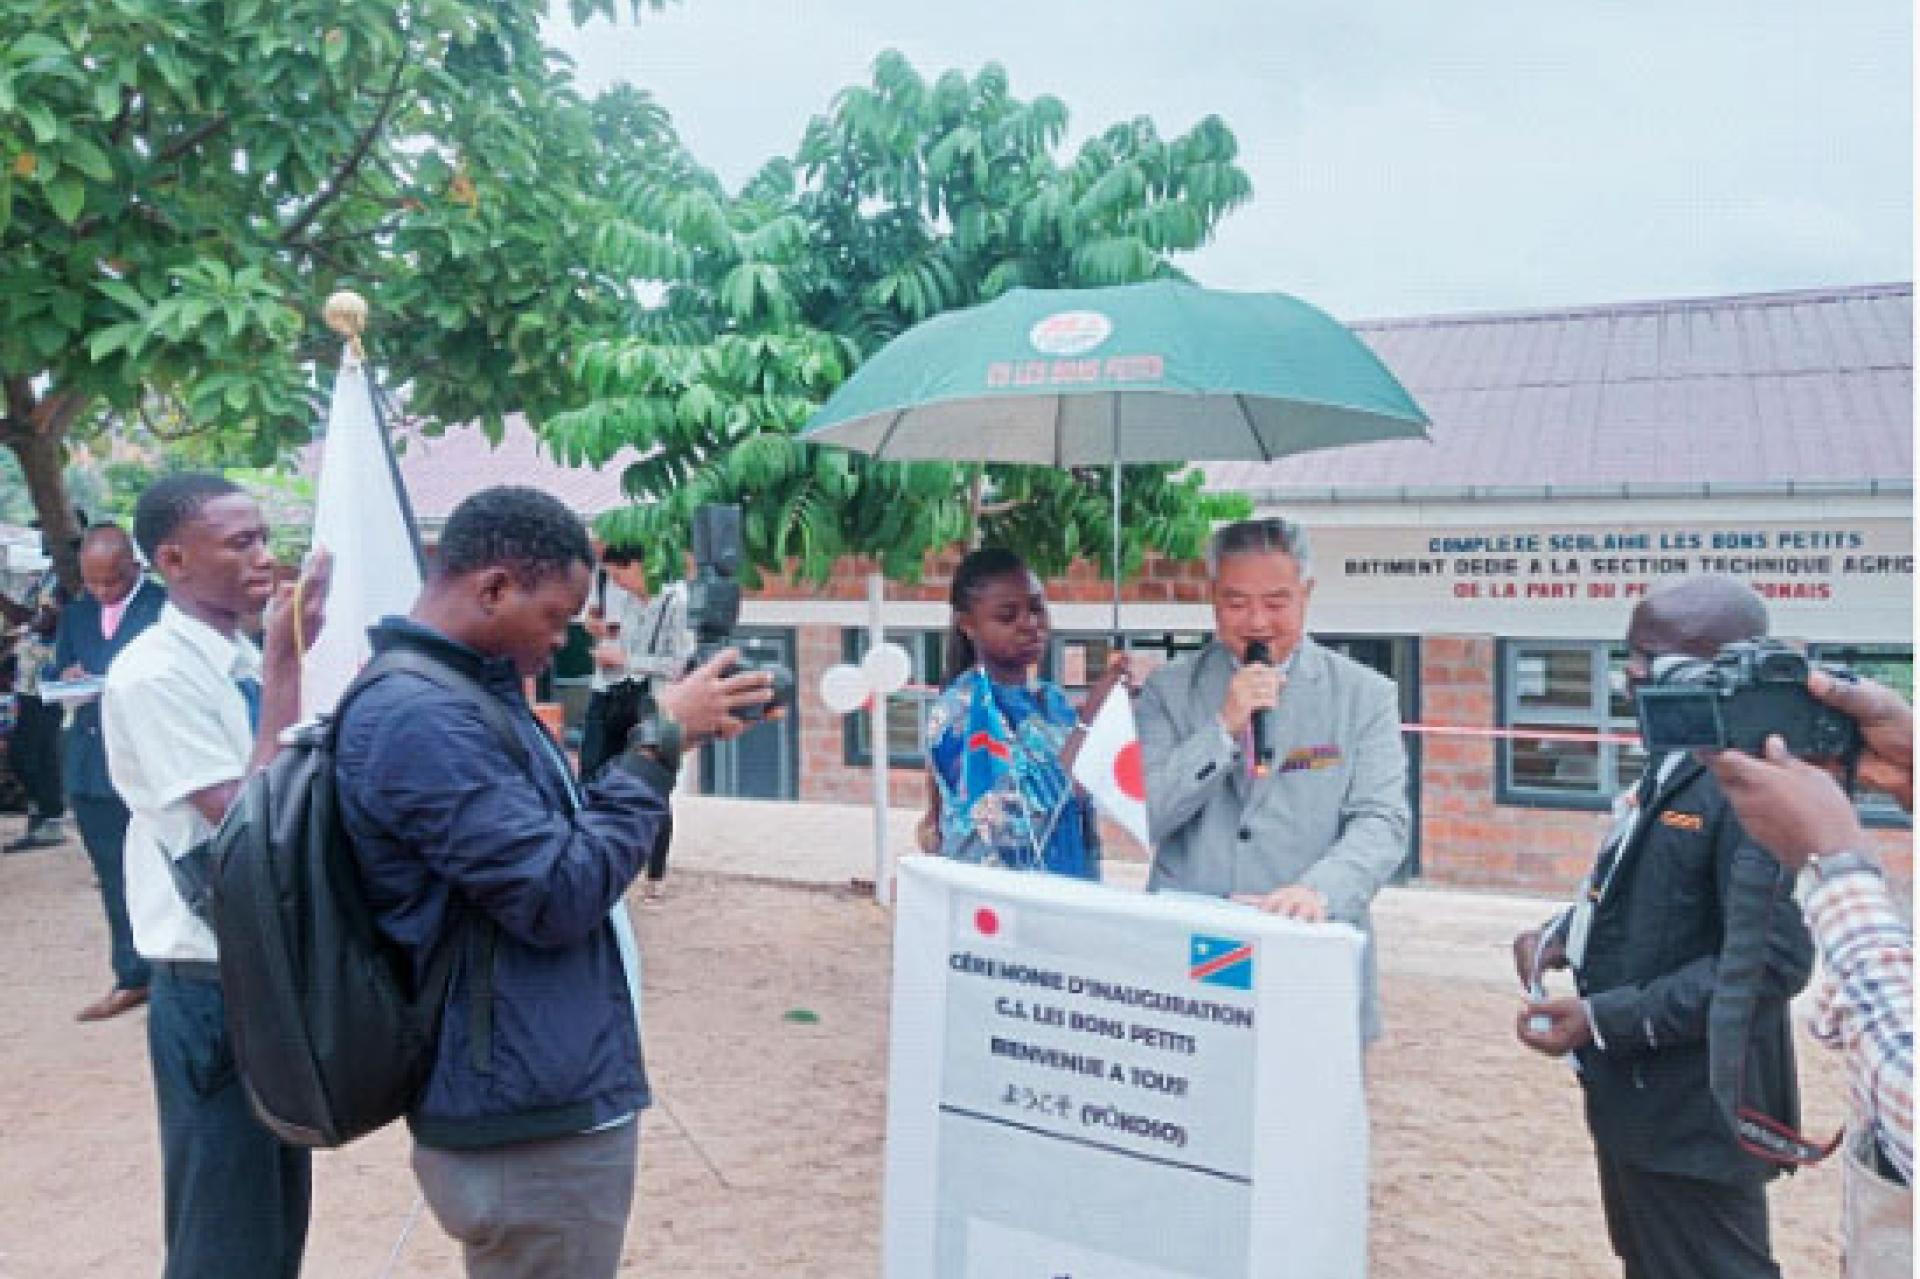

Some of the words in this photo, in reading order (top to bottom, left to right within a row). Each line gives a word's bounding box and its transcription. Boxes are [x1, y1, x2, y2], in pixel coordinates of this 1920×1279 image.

[1429, 534, 1539, 552] COMPLEXE
[1660, 533, 1702, 550] LES
[1712, 532, 1767, 549] BONS
[1779, 531, 1864, 549] PETITS
[1551, 558, 1580, 575] LA
[1591, 557, 1689, 575] SECTION
[1700, 556, 1831, 575] TECHNIQUE
[1453, 582, 1479, 598] DE
[1490, 582, 1518, 598] LA
[1527, 582, 1577, 598] PART
[1587, 582, 1615, 598] DU
[1033, 1003, 1065, 1028] LES
[1069, 1010, 1125, 1040] BONS
[1128, 1024, 1196, 1056] PETITS
[990, 1034, 1104, 1078] BIENVENUE
